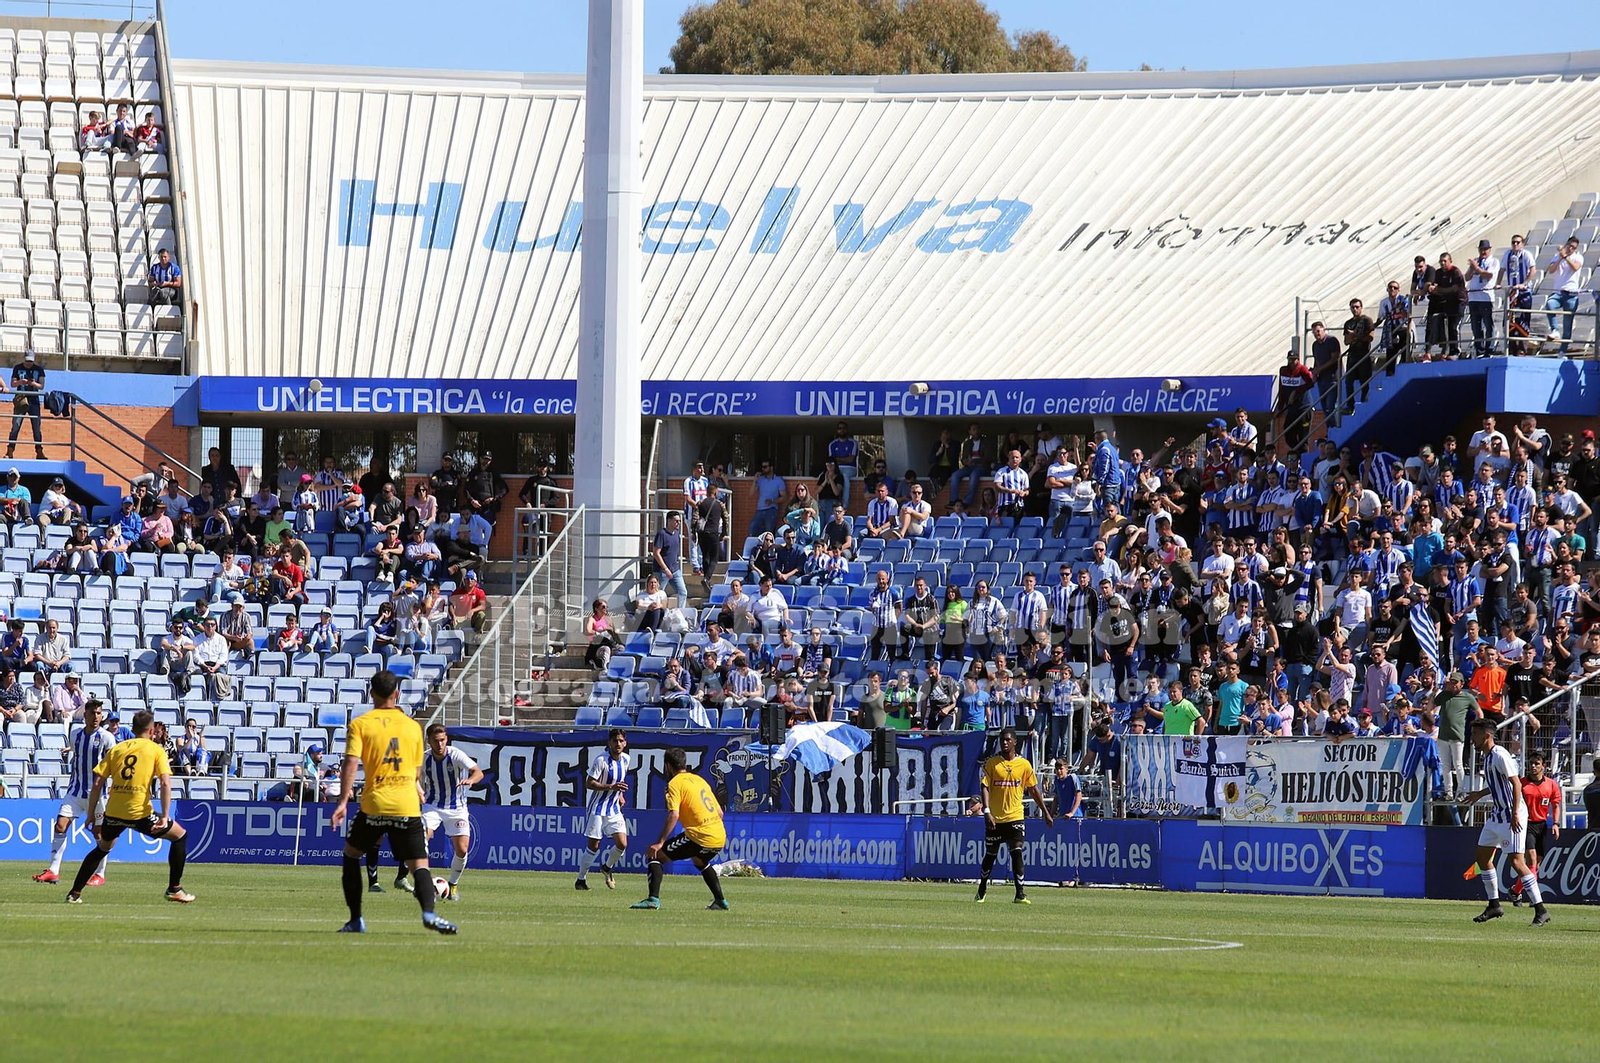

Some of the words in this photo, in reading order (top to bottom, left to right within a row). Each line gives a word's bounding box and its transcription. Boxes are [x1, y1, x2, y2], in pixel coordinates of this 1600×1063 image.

[337, 178, 1034, 254] Huelva
[257, 386, 486, 414] UNIELECTRICA
[795, 389, 1001, 417] UNIELECTRICA
[1043, 389, 1114, 415] energía
[1122, 388, 1149, 413] del
[382, 737, 402, 771] 4
[1324, 743, 1377, 763] SECTOR
[120, 754, 138, 780] 8
[1281, 764, 1419, 804] HELICÓSTERO
[699, 788, 715, 813] 6
[216, 806, 306, 837] TDC
[511, 812, 571, 834] HOTEL
[1328, 813, 1339, 823] DEL
[220, 847, 263, 856] INTERNET
[264, 848, 278, 857] DE
[487, 845, 556, 866] ALONSO
[1198, 829, 1384, 887] ALQUIBOXES
